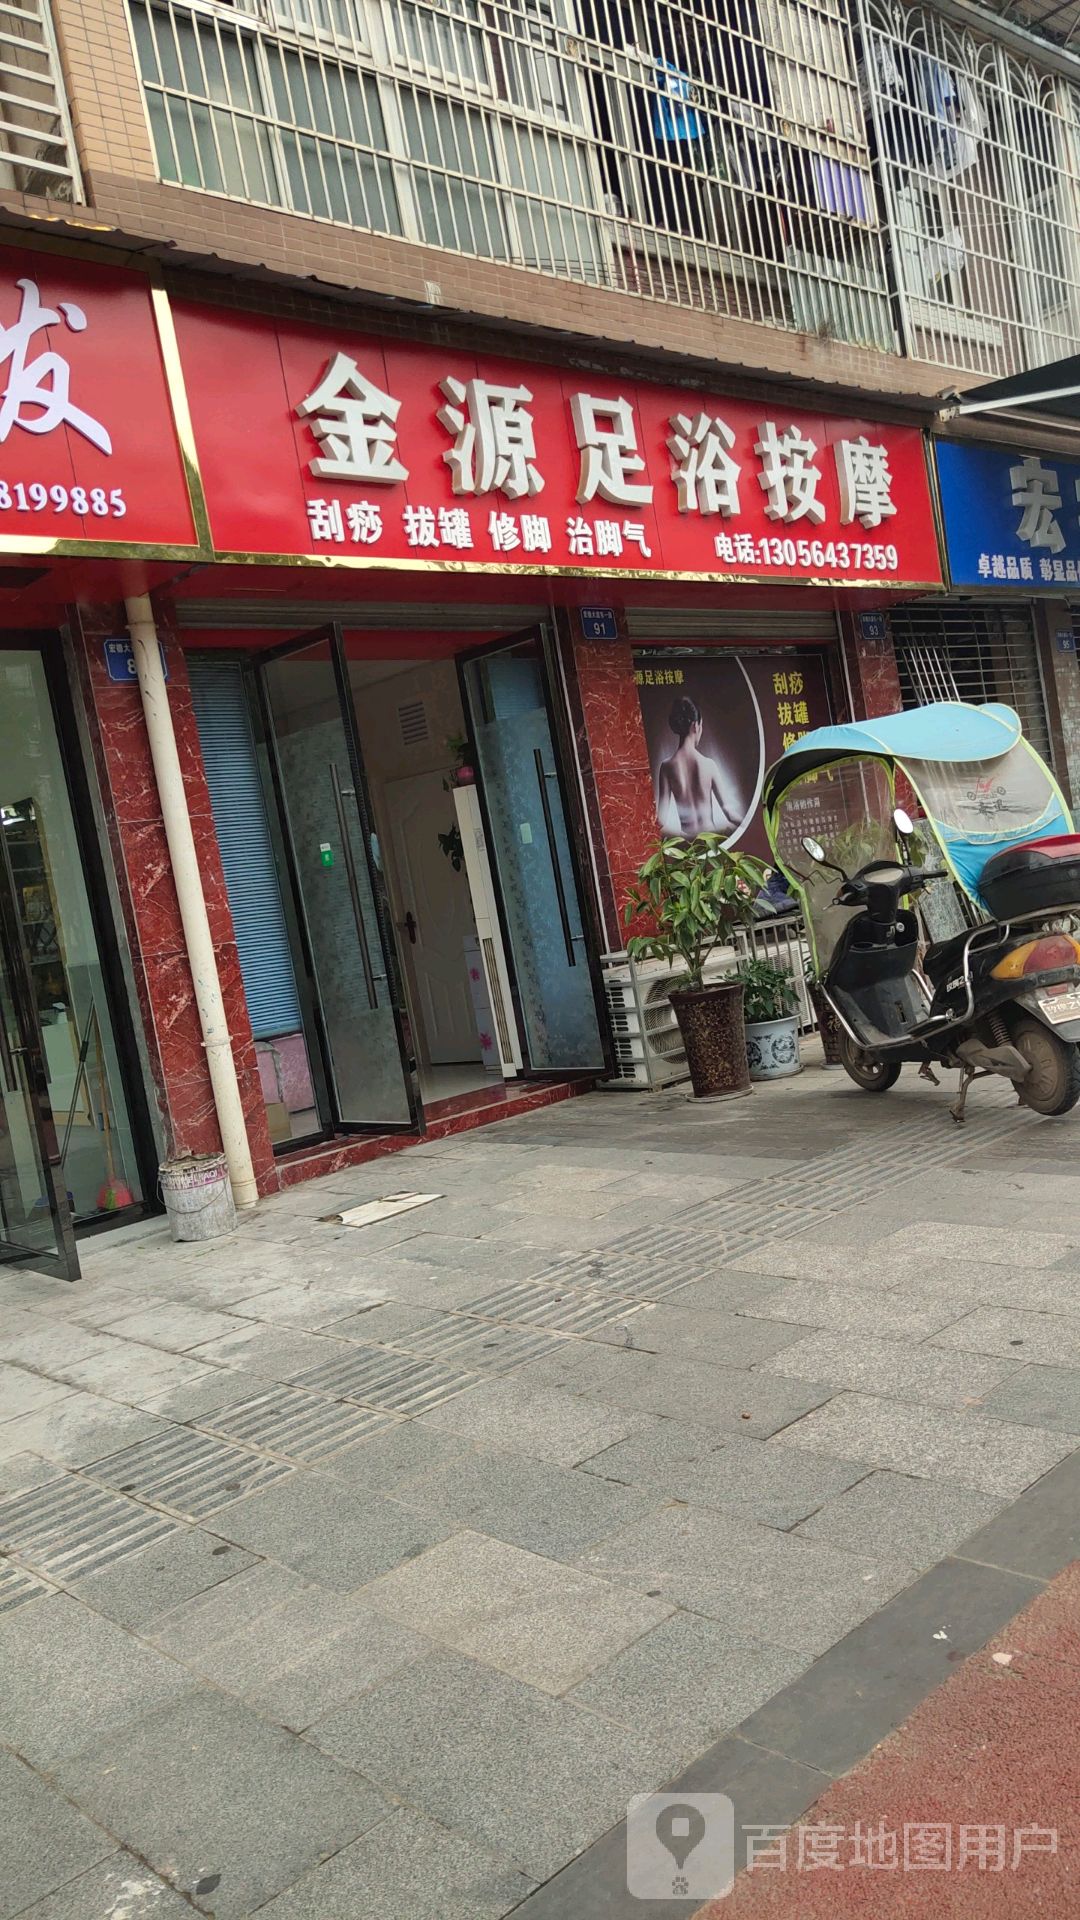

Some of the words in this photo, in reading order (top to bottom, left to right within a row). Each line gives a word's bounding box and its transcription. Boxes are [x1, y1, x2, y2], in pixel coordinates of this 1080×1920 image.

[295, 351, 898, 530] 金源足浴按摩
[1009, 459, 1080, 554] 宏
[307, 498, 384, 544] 刮痧
[402, 504, 475, 549] 拔罐
[487, 510, 553, 553] 修脚
[566, 516, 652, 558] 治脚气
[978, 553, 1034, 580] 卓越品质
[1039, 557, 1080, 582] 彰显品
[593, 622, 606, 635] 91
[869, 624, 879, 636] 93
[772, 671, 804, 696] 刮痧
[776, 700, 810, 726] 拔罐
